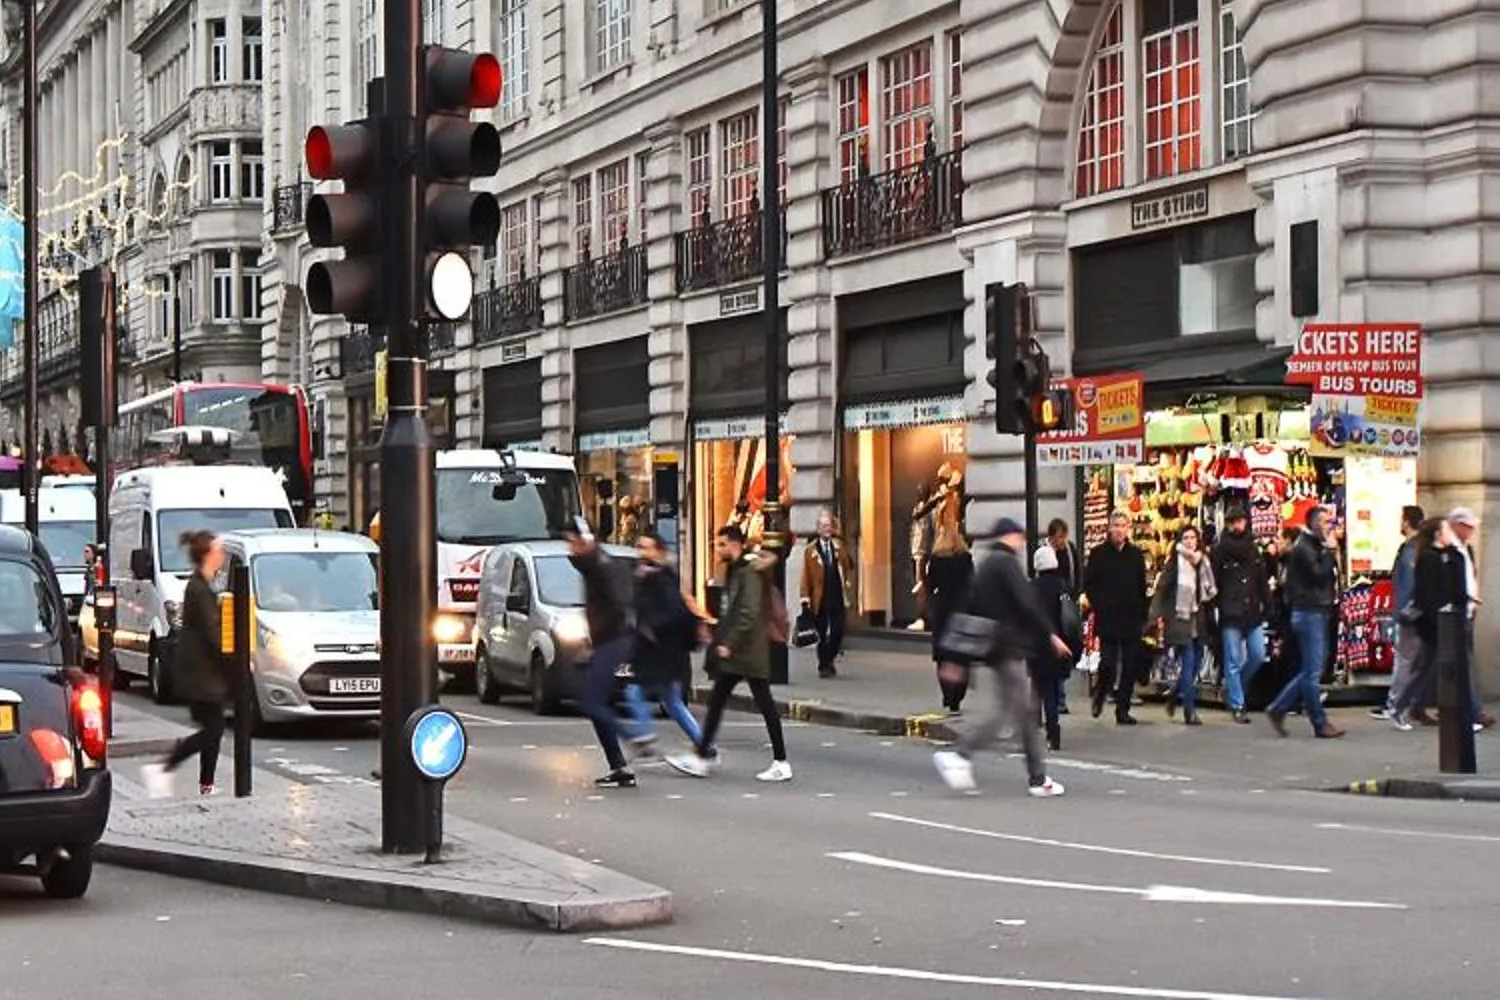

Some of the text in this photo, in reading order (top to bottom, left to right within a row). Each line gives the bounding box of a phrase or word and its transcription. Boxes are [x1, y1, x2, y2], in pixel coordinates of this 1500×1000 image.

[1134, 201, 1159, 223] THE
[1162, 190, 1206, 217] STING
[1293, 329, 1418, 355] ICKETS HERE
[1372, 360, 1391, 373] BUS
[1320, 375, 1418, 395] BUS TOURS
[1099, 385, 1137, 412] TICKETS
[1371, 396, 1412, 413] TICKETS
[335, 679, 379, 691] LY15 EPU
